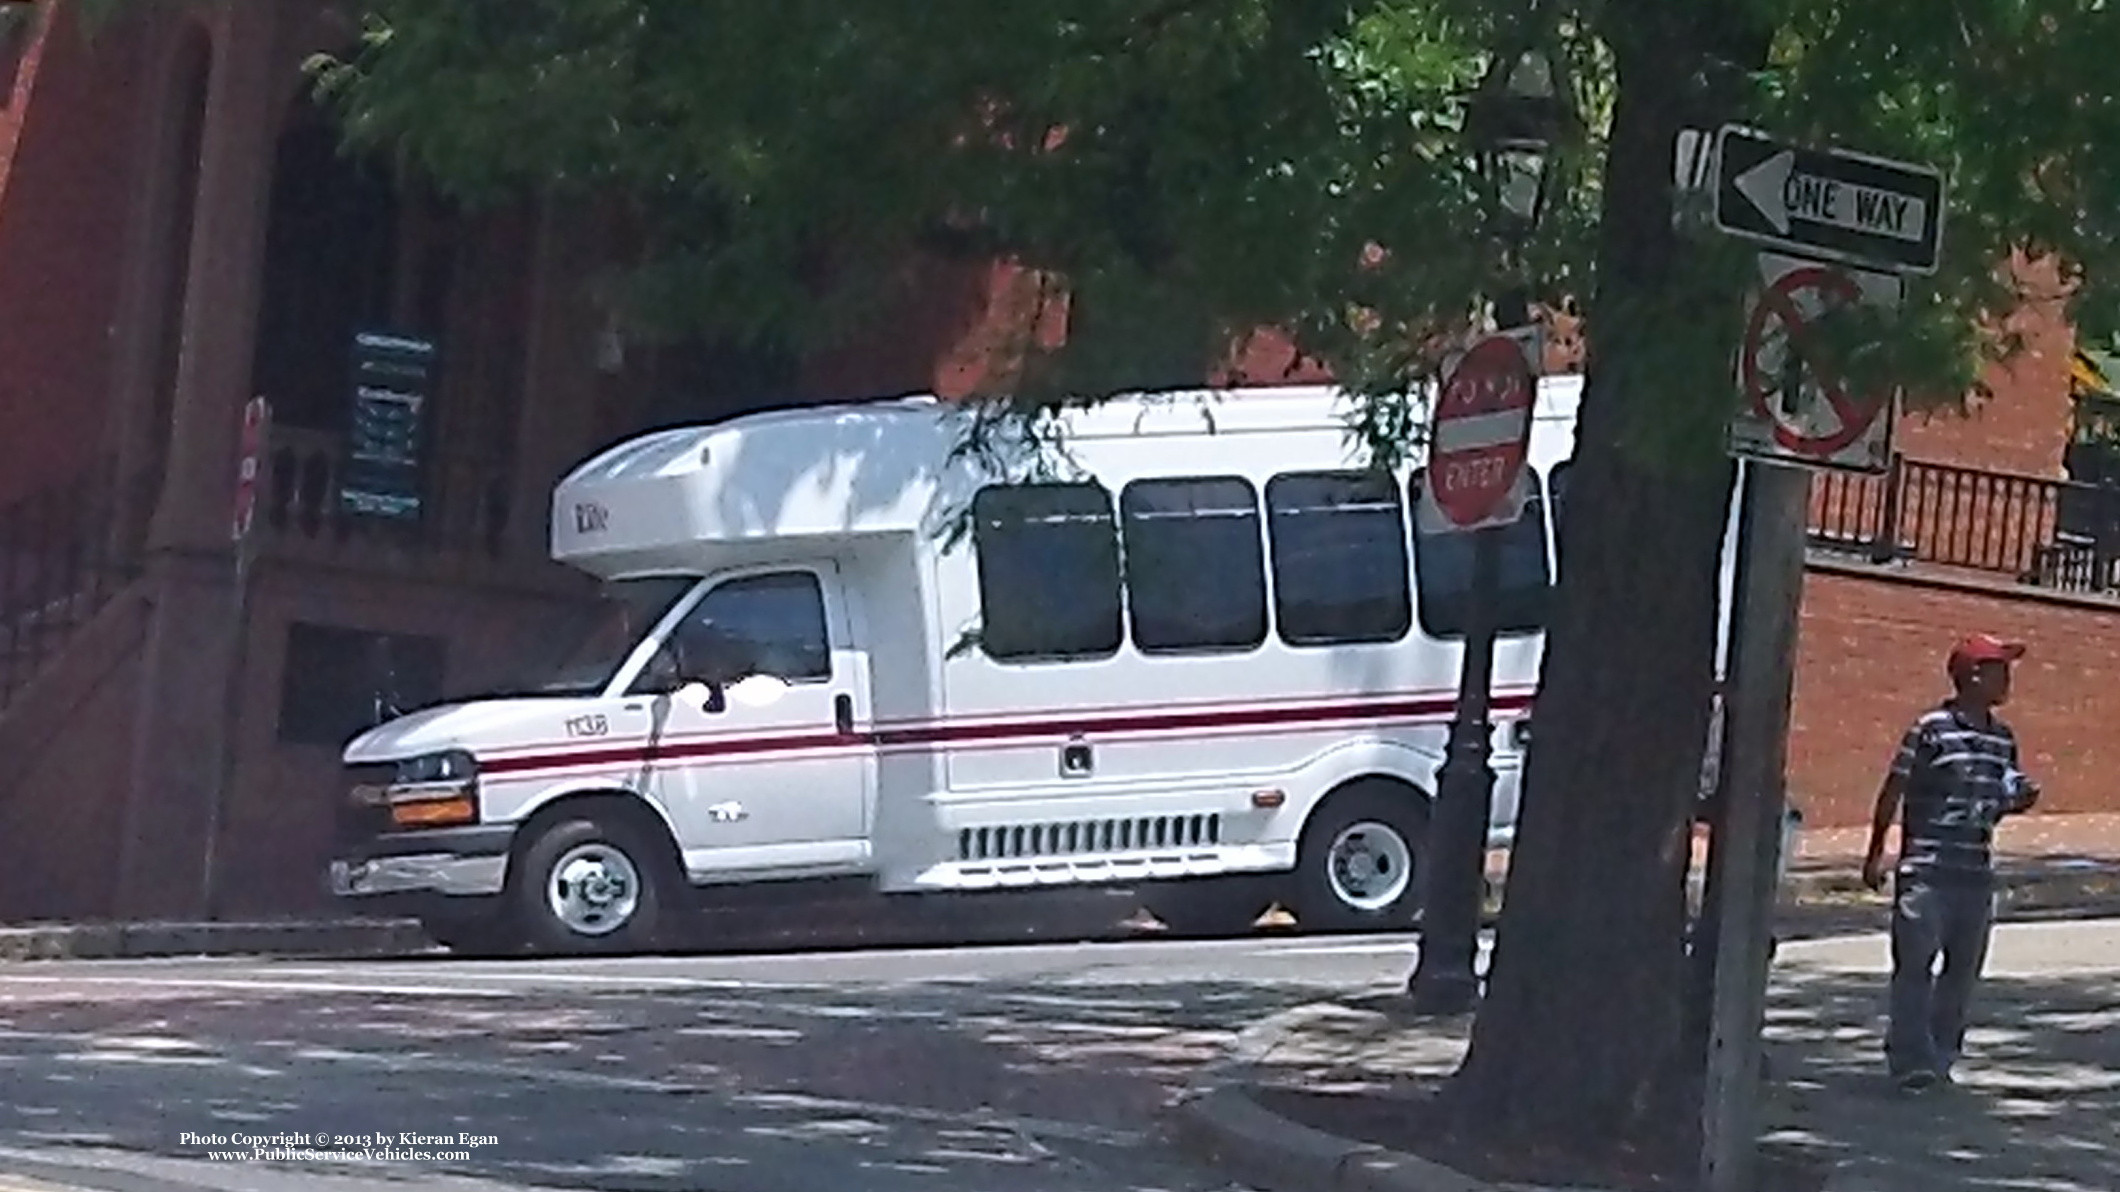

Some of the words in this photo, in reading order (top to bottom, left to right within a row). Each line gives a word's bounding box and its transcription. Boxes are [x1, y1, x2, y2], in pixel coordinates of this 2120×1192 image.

[1783, 171, 1836, 219] ONE
[1855, 188, 1909, 232] WAY
[1445, 456, 1506, 491] ENTER
